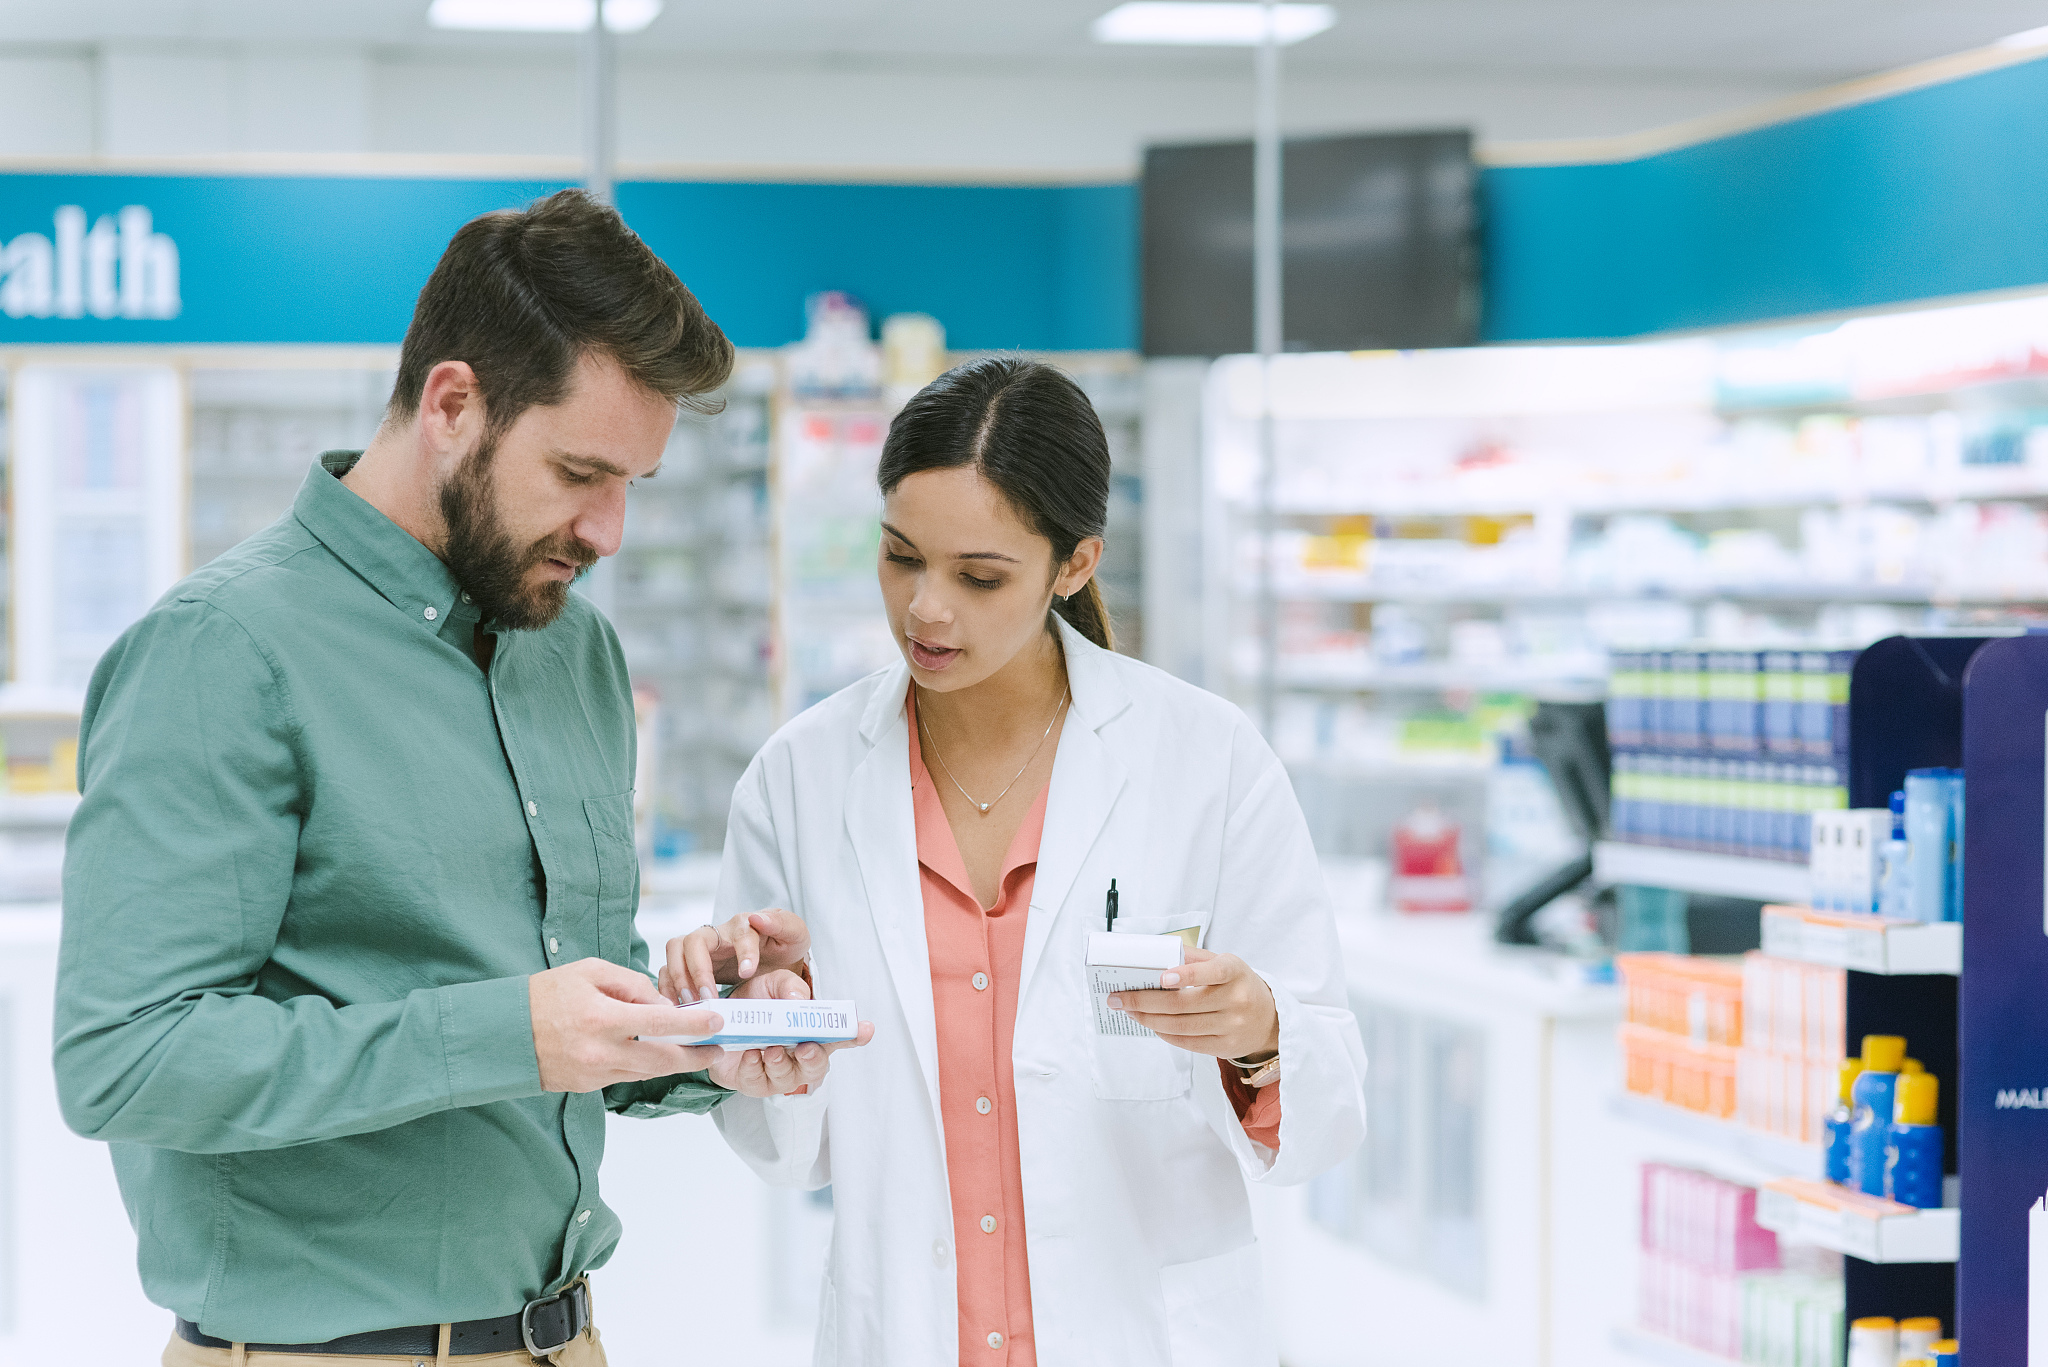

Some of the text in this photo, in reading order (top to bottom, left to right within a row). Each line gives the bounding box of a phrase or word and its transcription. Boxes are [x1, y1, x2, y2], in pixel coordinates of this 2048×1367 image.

[0, 204, 181, 320] alth
[730, 1010, 848, 1029] MEDICOLINS ALLERGY
